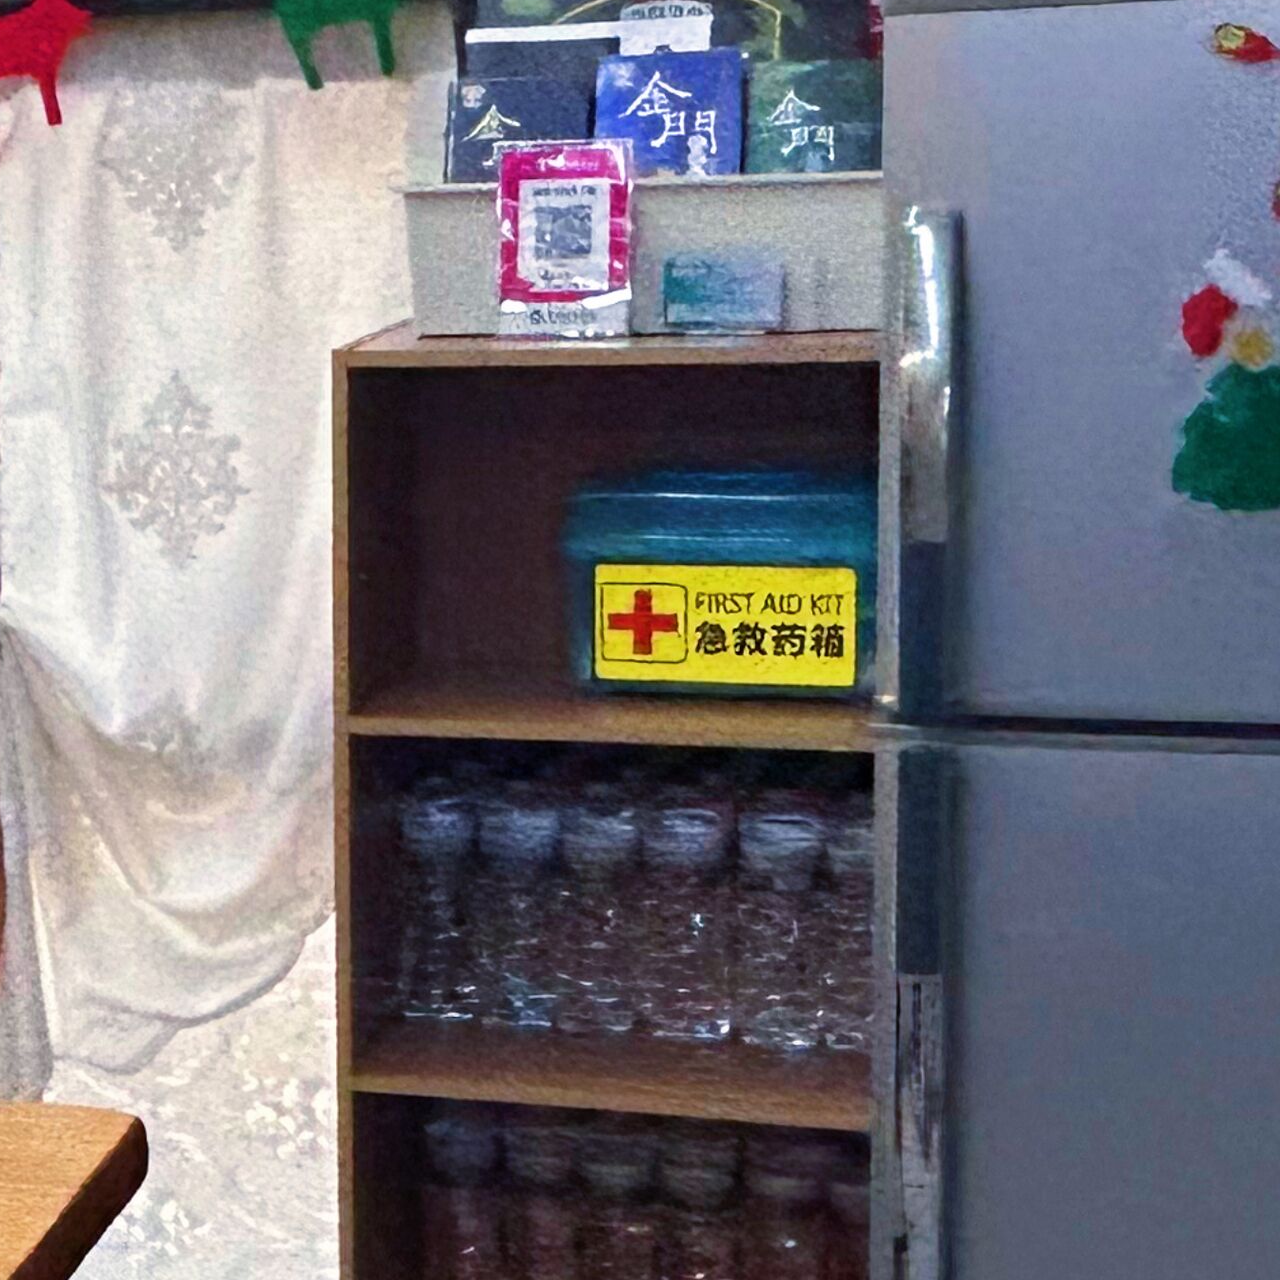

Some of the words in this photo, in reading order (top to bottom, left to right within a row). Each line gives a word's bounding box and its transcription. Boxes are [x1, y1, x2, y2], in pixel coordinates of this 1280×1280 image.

[618, 70, 717, 155] 金門
[766, 89, 835, 161] 金門
[694, 591, 755, 614] FIRST
[760, 592, 802, 615] AID
[810, 594, 844, 616] KIT
[693, 620, 845, 658] 急救药箱
